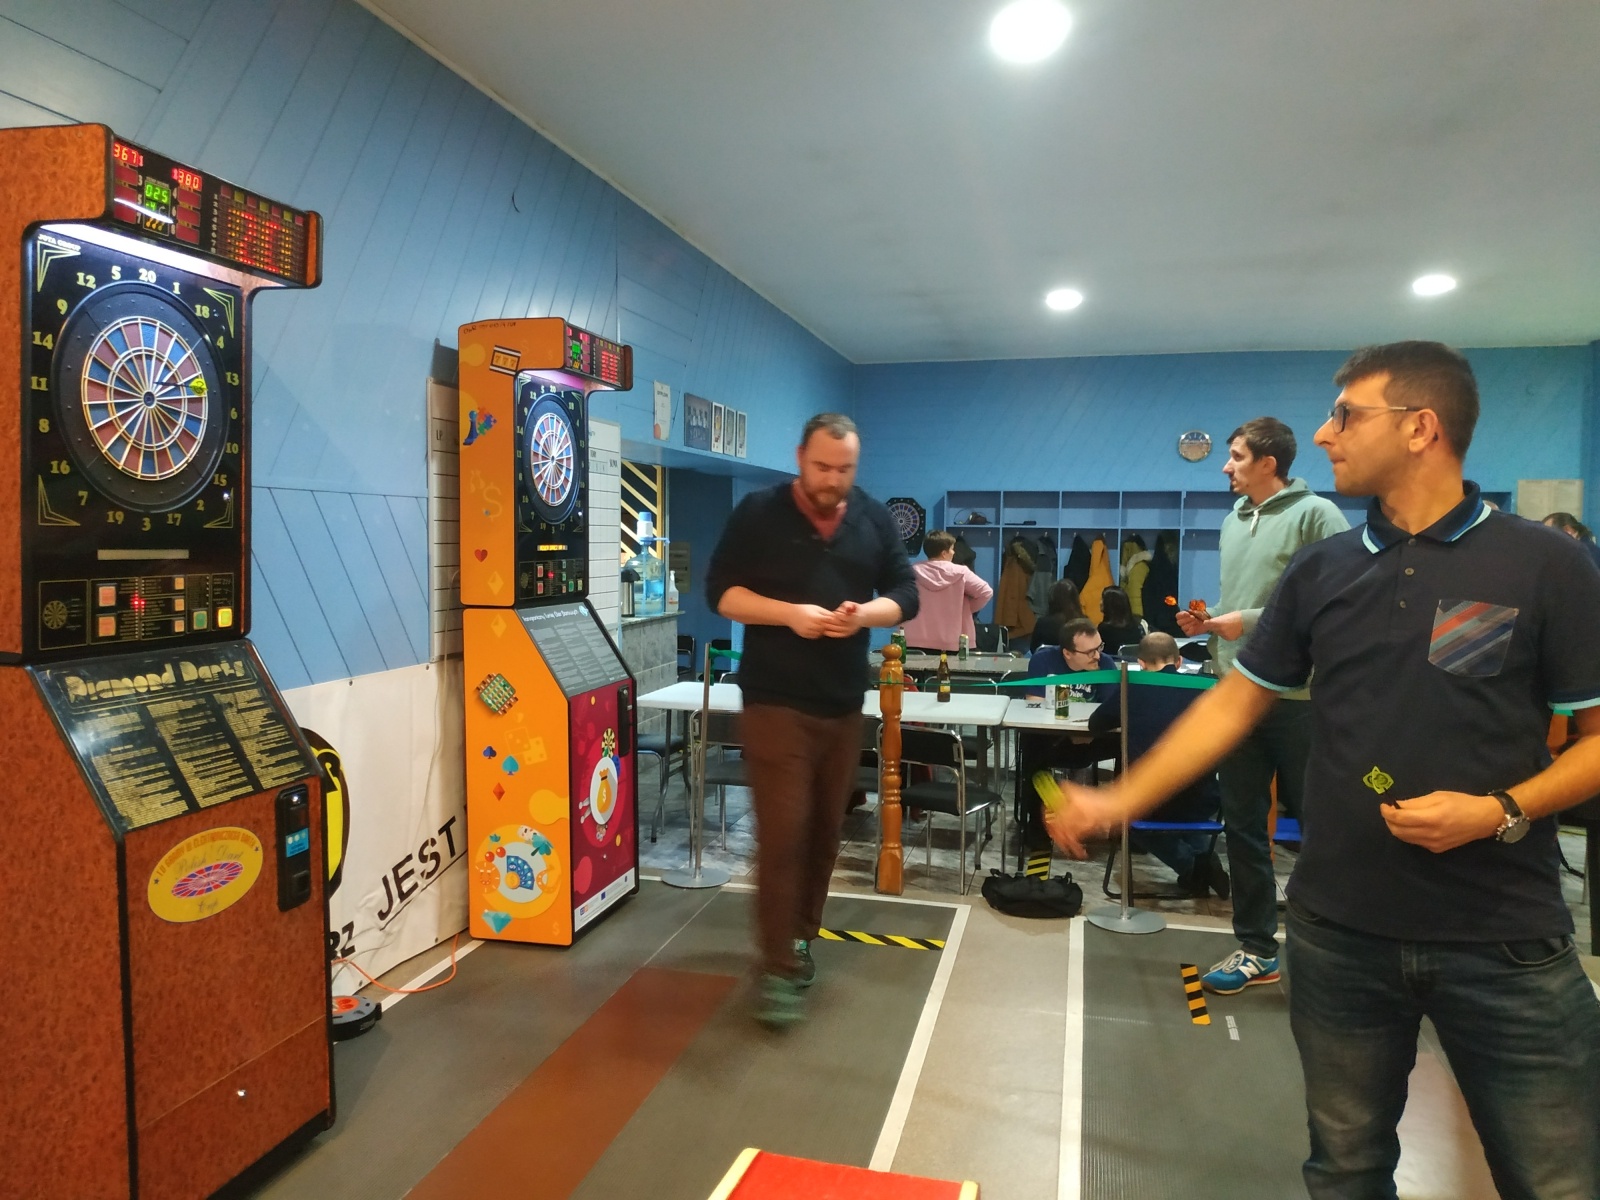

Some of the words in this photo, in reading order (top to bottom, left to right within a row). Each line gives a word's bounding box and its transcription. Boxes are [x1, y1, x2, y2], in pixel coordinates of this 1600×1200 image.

[114, 143, 137, 164] 367
[178, 171, 200, 189] 380
[145, 184, 168, 203] 025
[111, 265, 121, 280] 5
[138, 267, 157, 283] 20
[76, 272, 96, 289] 12
[172, 281, 181, 294] 1
[56, 299, 68, 315] 9
[194, 304, 210, 319] 18
[32, 331, 54, 350] 14
[216, 336, 225, 349] 4
[31, 376, 49, 391] 11
[225, 371, 240, 386] 13
[230, 407, 238, 420] 6
[38, 418, 50, 433] 8
[225, 442, 239, 454] 10
[50, 460, 70, 475] 16
[213, 473, 227, 487] 15
[78, 490, 89, 506] 7
[196, 499, 205, 511] 2
[106, 510, 125, 525] 19
[142, 517, 151, 531] 3
[166, 512, 182, 527] 17
[64, 661, 176, 704] Diamond
[377, 816, 456, 922] JEST
